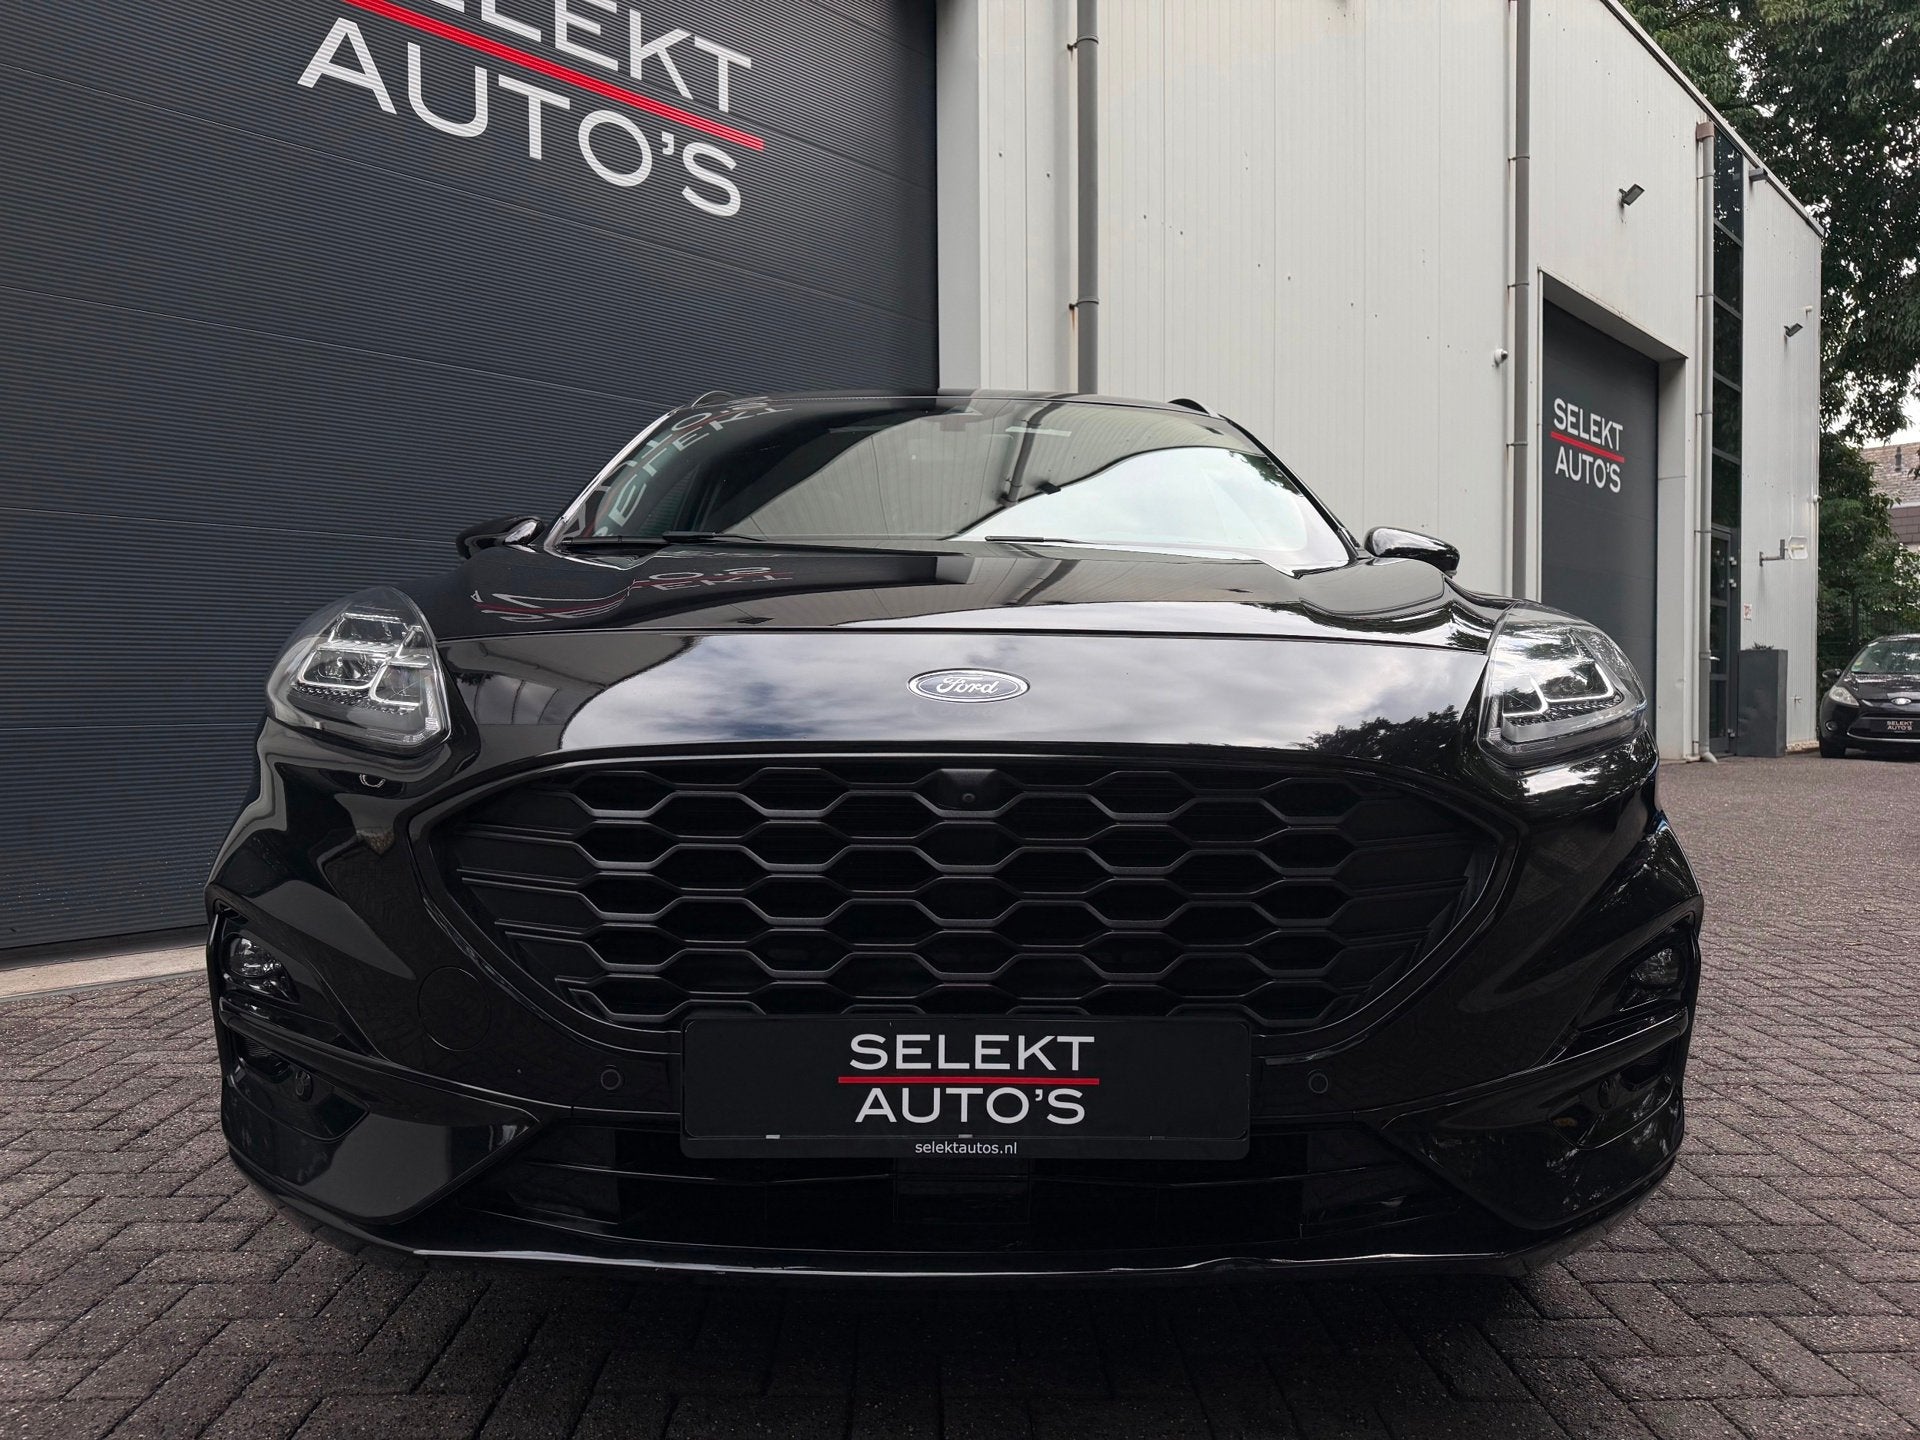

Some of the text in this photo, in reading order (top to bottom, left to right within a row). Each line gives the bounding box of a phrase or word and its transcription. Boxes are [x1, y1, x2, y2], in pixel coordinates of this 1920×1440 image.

[297, 17, 742, 217] AUTO'S
[1553, 397, 1624, 452] SELEKT
[1555, 446, 1622, 493] AUTO'S
[936, 675, 1000, 695] Ford
[850, 1033, 1095, 1071] SELEKT
[854, 1086, 1086, 1125] AUTO'S
[915, 1141, 1017, 1154] selektautos.nl
